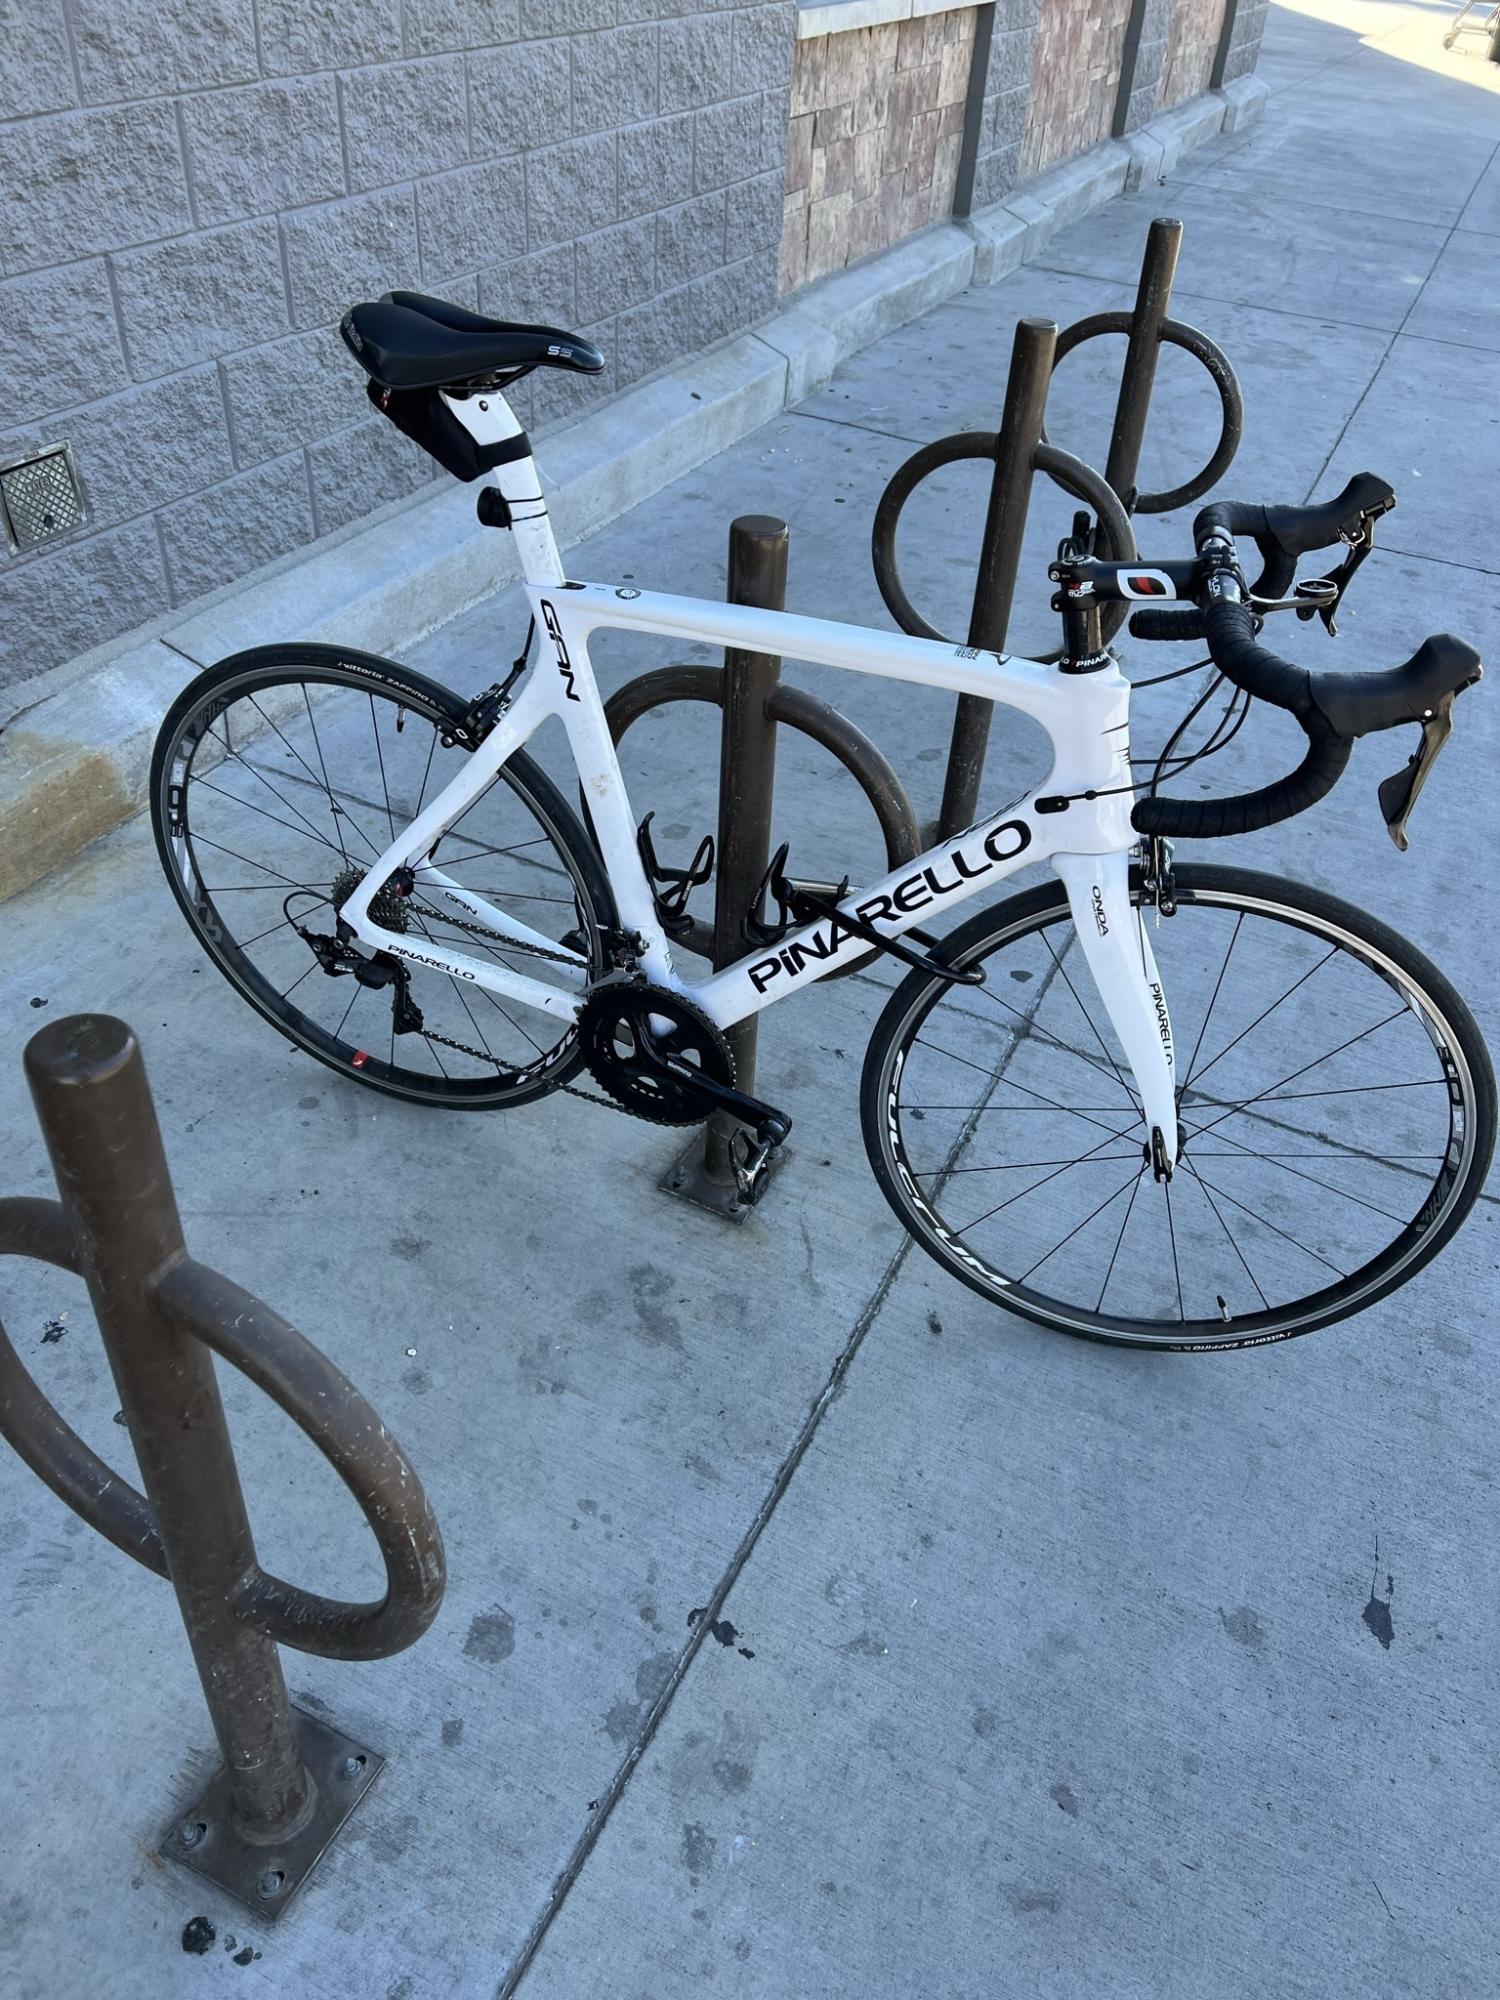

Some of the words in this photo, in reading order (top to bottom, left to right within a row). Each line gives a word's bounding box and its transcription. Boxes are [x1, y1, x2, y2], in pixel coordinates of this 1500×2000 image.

[25, 475, 51, 495] WATER
[1212, 575, 1222, 598] YLON
[540, 598, 581, 702] GAN
[1075, 653, 1109, 668] PINAR
[445, 892, 478, 915] GAN
[748, 819, 1032, 994] PINARELLO
[1092, 885, 1109, 937] ONDA
[388, 944, 475, 980] PINARELLO
